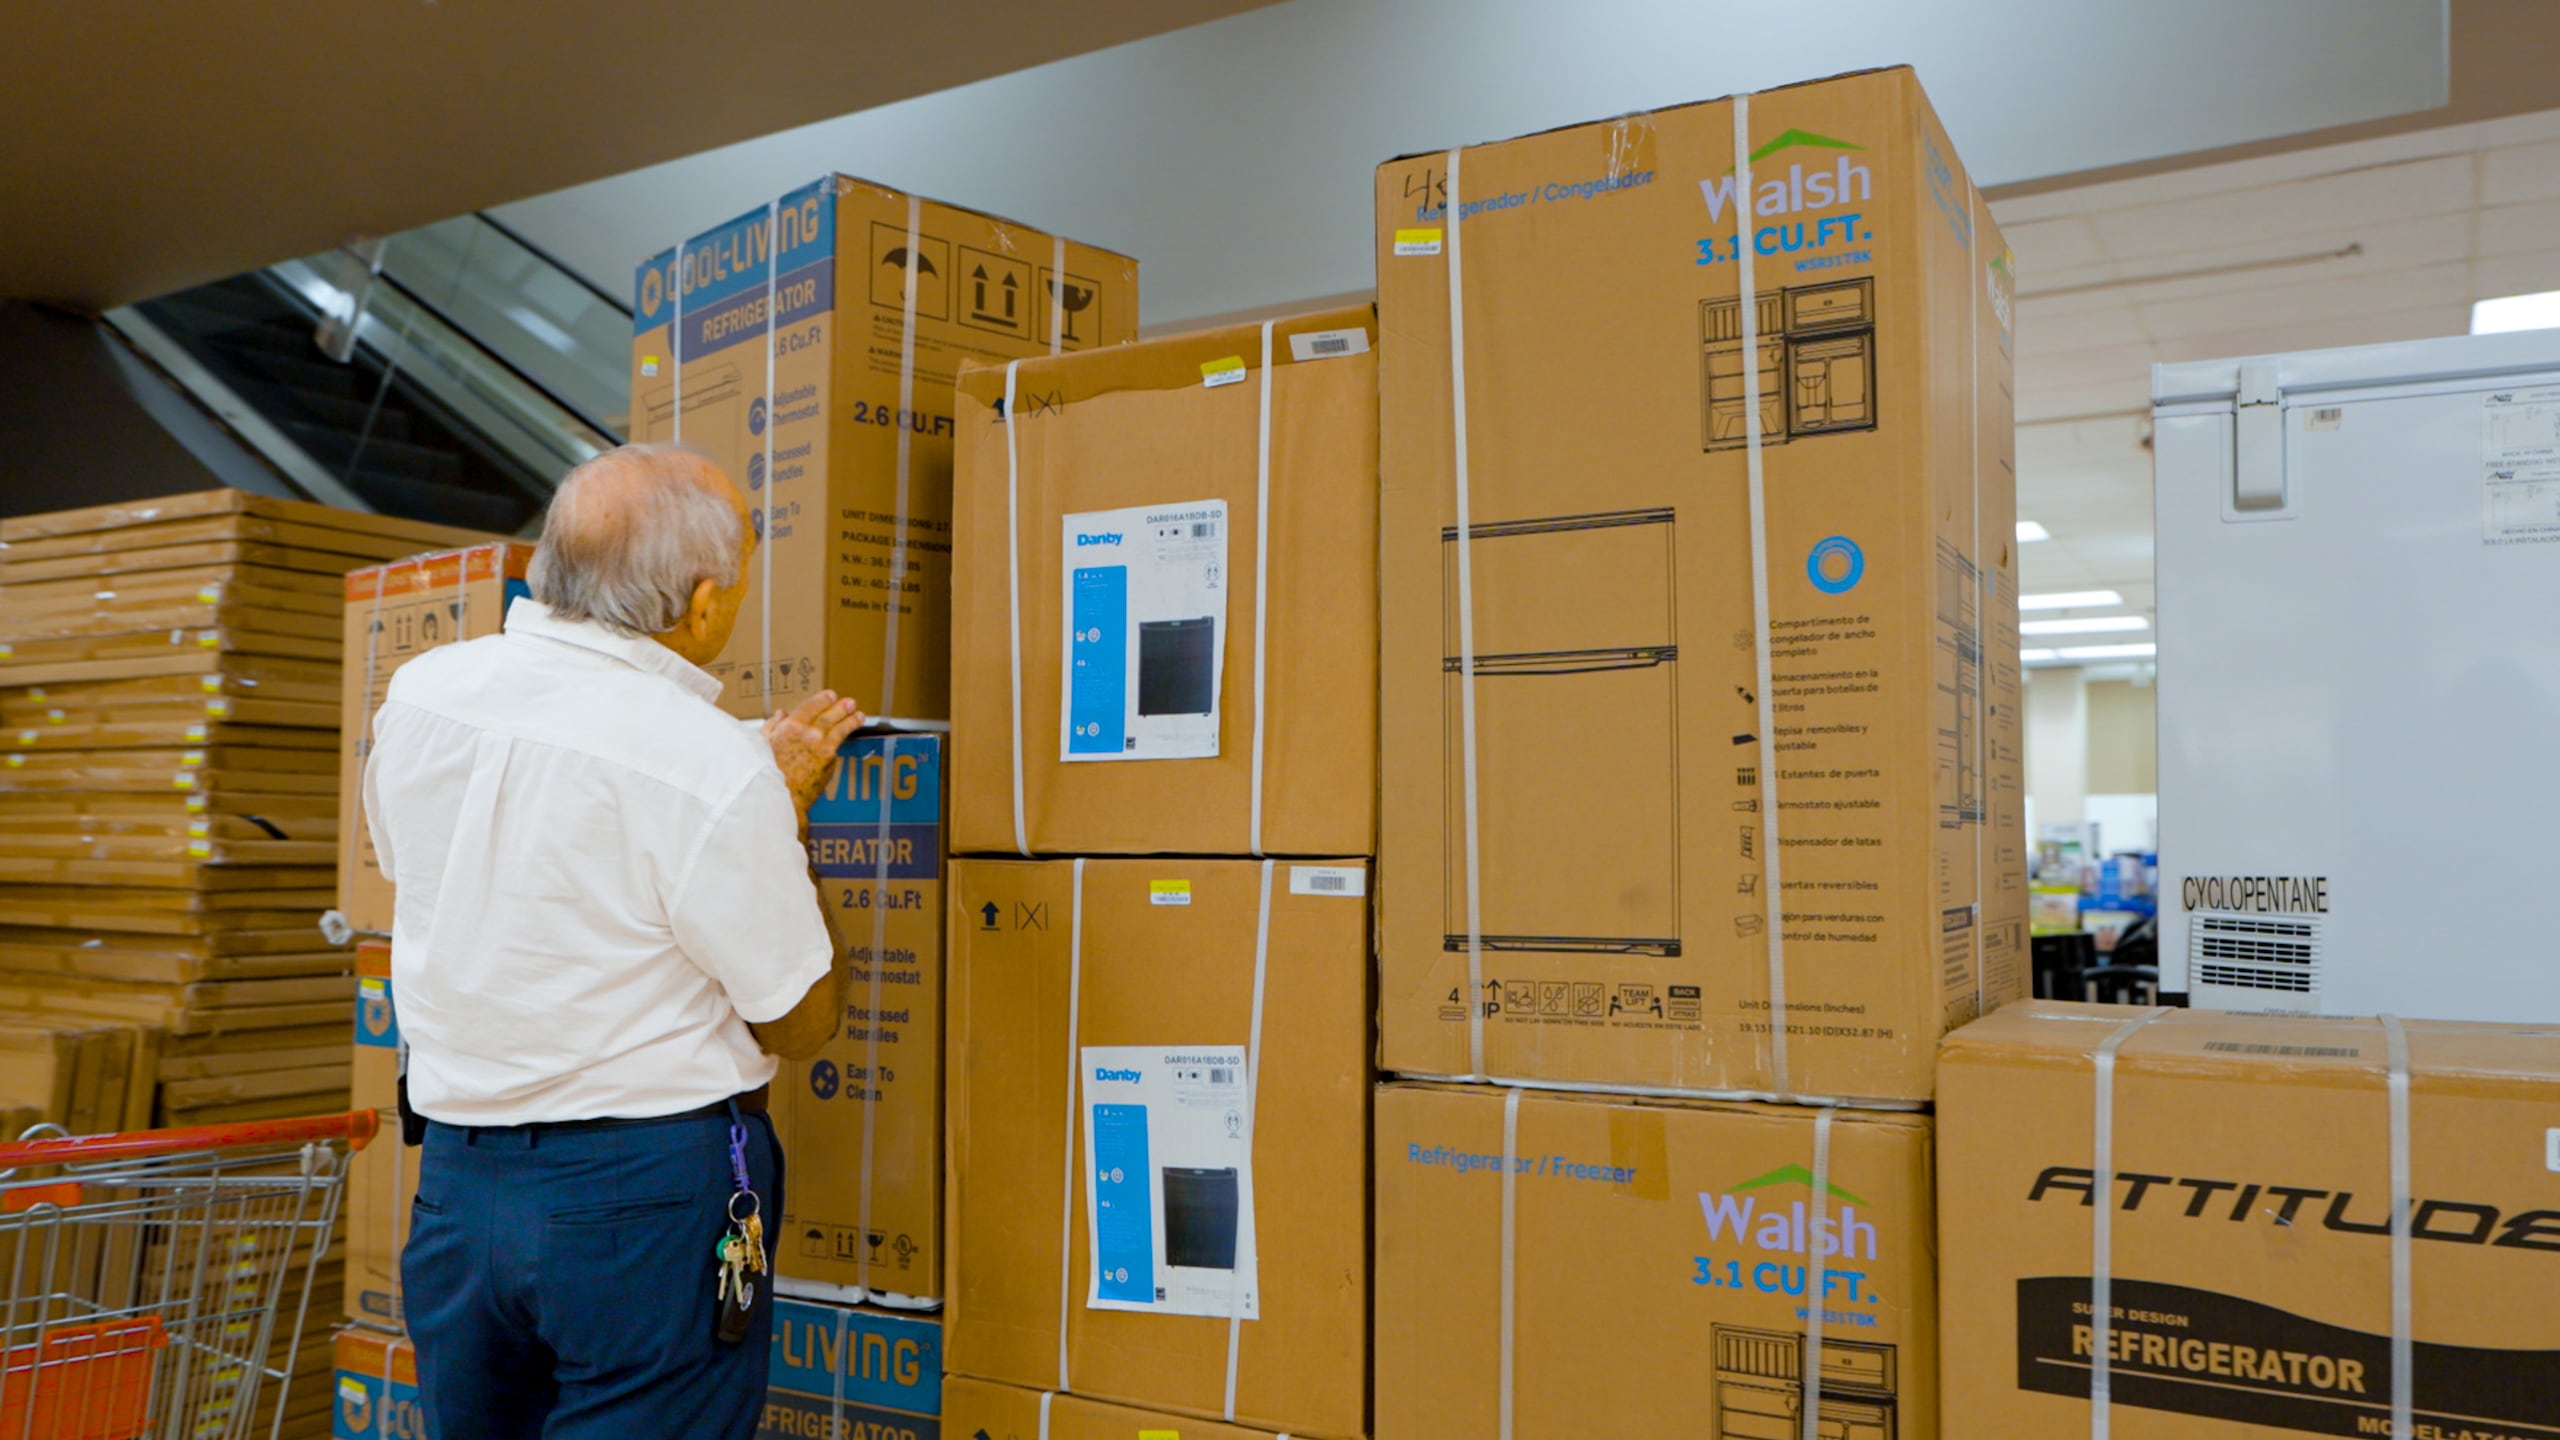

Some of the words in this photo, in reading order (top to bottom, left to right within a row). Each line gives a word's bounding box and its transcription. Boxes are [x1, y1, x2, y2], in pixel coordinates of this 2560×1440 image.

[1543, 170, 1655, 201] Congelador
[1699, 156, 1871, 225] Walsh
[1695, 233, 1740, 266] 3.1
[1753, 213, 1873, 256] CU.FT.
[854, 400, 890, 427] 2.6
[1077, 532, 1123, 547] Danby
[1856, 615, 1870, 624] de
[1828, 631, 1841, 640] de
[1844, 629, 1876, 640] ancho
[1855, 671, 1868, 679] en
[1869, 669, 1878, 678] la
[1803, 687, 1825, 697] para
[1866, 683, 1879, 692] de
[1828, 768, 1842, 778] de
[1844, 768, 1880, 780] puerta
[1841, 837, 1854, 846] de
[1856, 837, 1882, 847] latas
[842, 889, 870, 909] 2.6
[2183, 876, 2328, 913] CYCLOPENTANE
[1866, 914, 1885, 922] con
[1813, 932, 1826, 941] de
[1828, 933, 1877, 943] humedad
[1622, 988, 1649, 998] TEAM
[1739, 1000, 1760, 1010] Unit
[879, 1066, 895, 1083] To
[1096, 1067, 1142, 1085] Danby
[1552, 1155, 1637, 1184] Freezer
[2027, 1165, 2560, 1252] ATTITUDE
[1697, 1191, 1878, 1261] Walsh
[1691, 1255, 1744, 1289] 3.1
[2127, 1308, 2189, 1328] DESIGN
